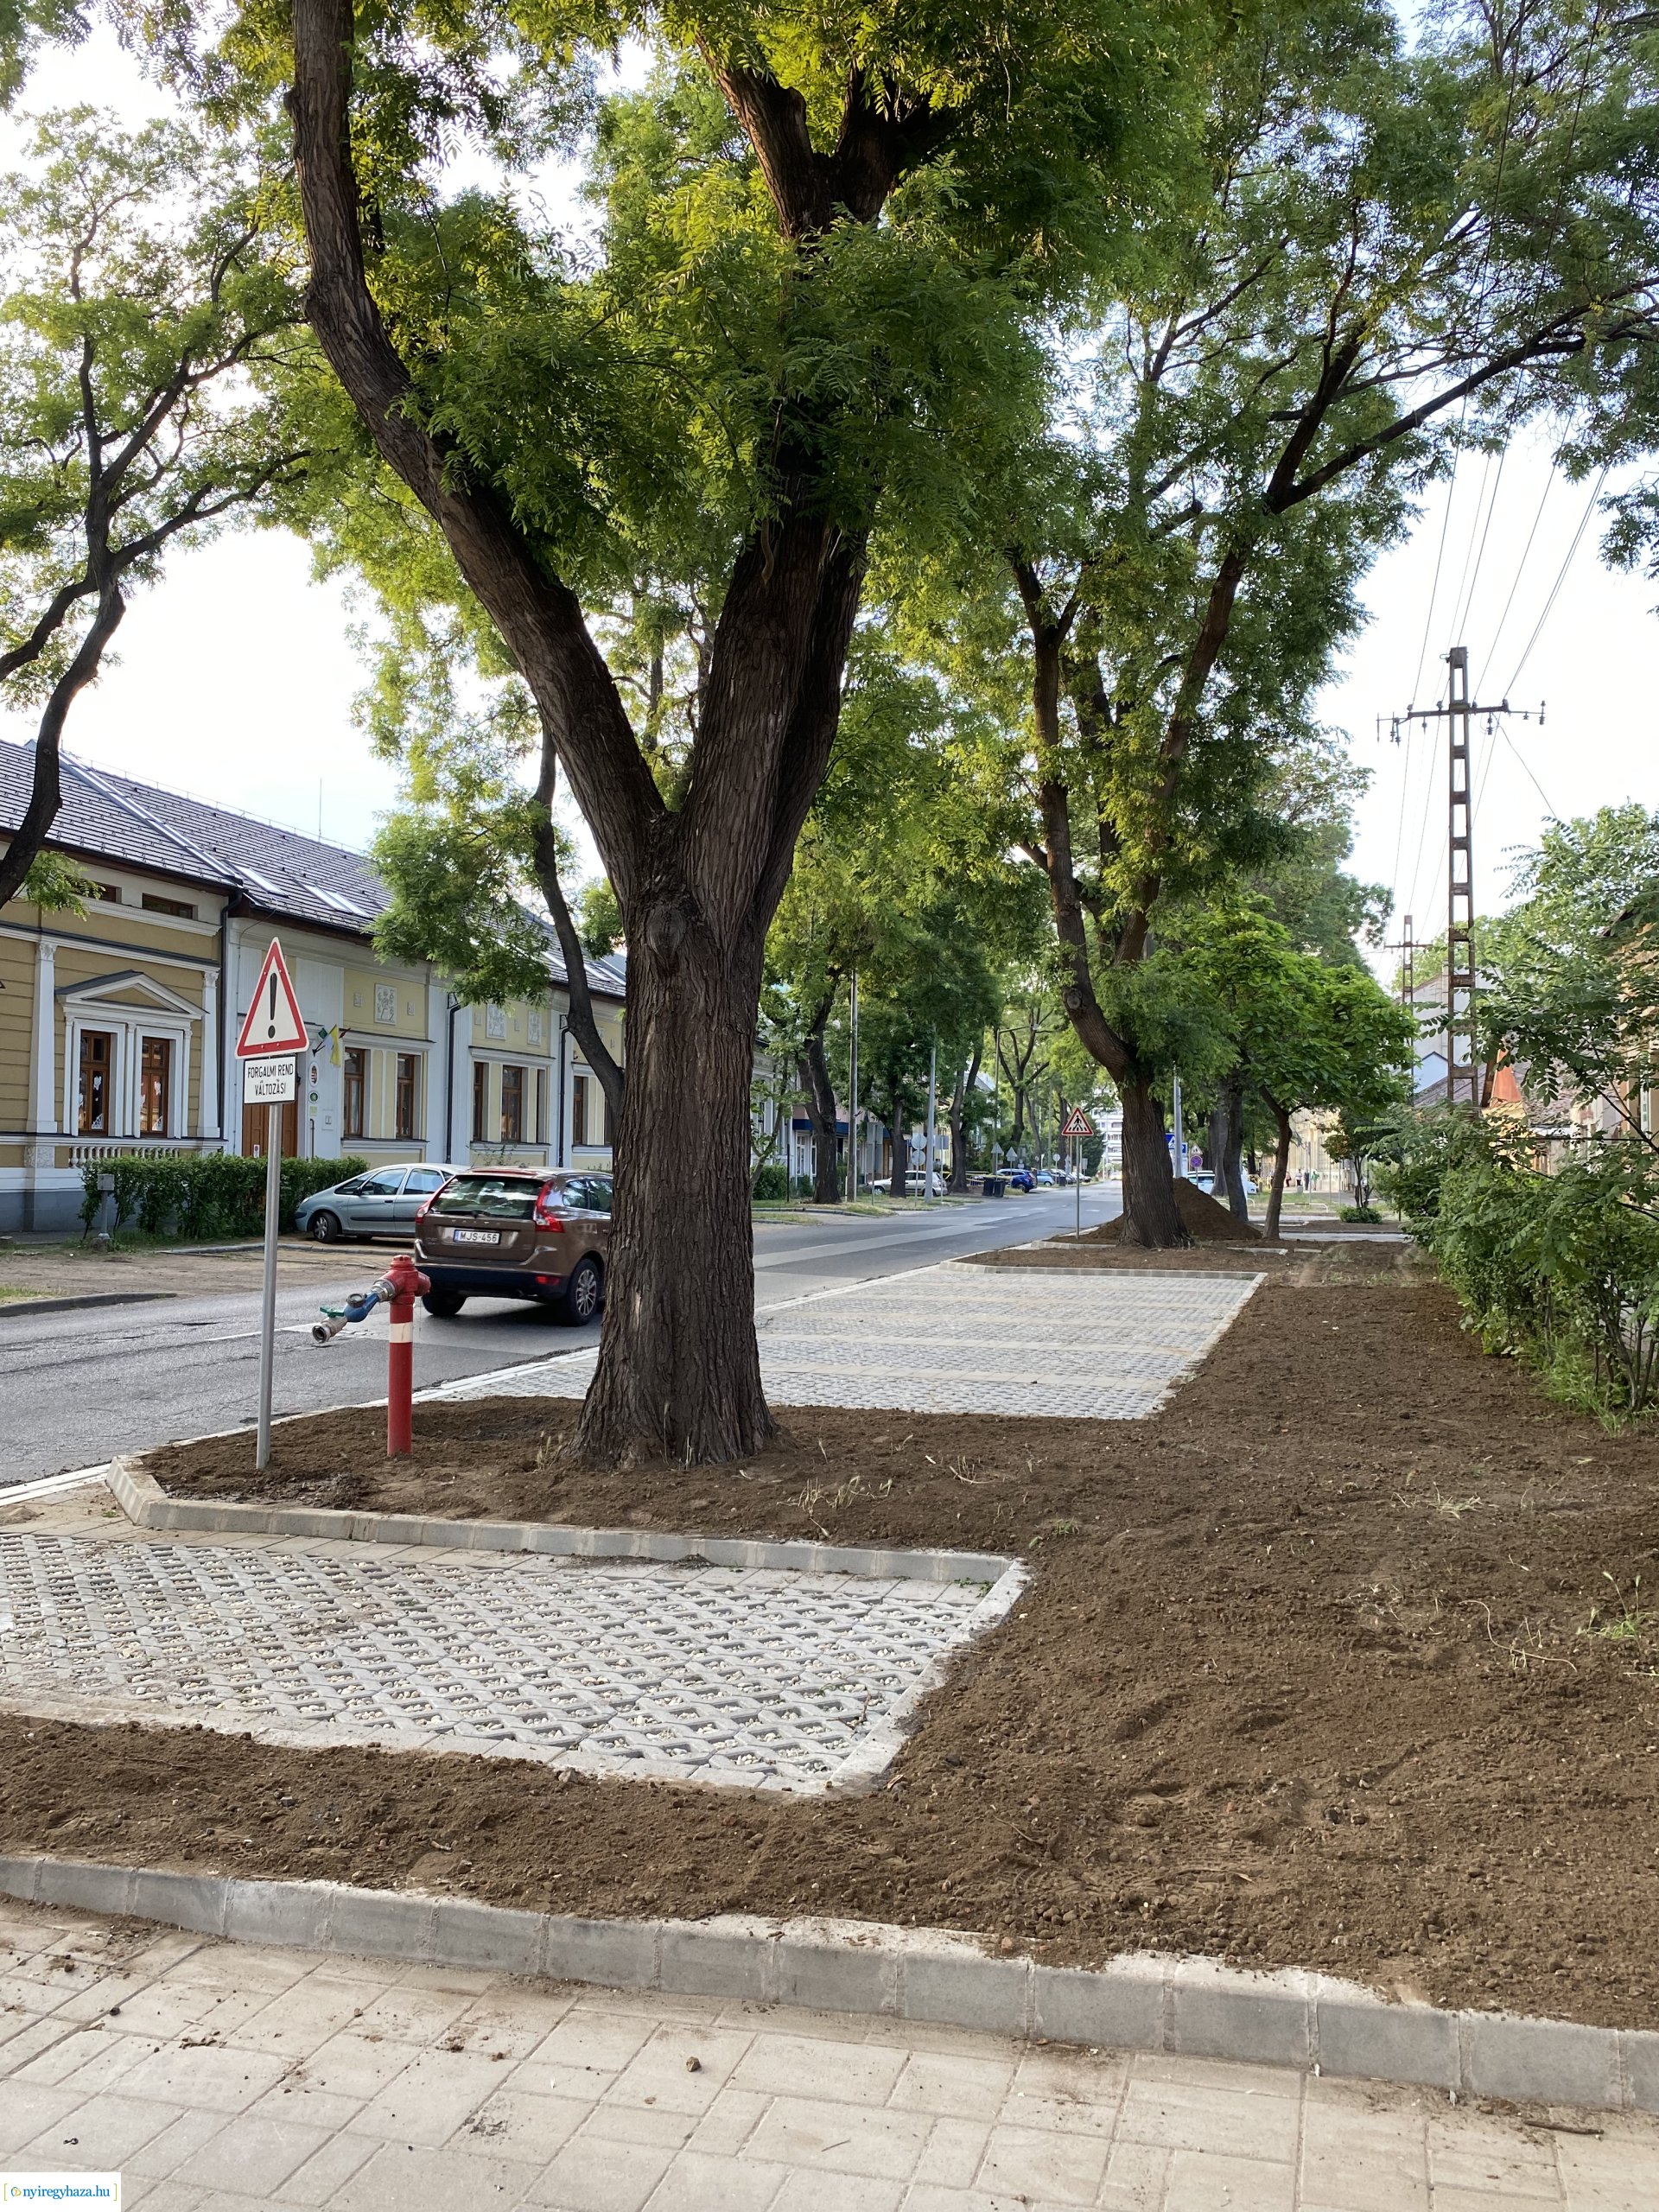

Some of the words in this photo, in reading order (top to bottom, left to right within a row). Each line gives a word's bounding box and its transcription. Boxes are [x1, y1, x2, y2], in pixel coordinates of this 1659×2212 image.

[247, 1065, 276, 1078] FORGALMI
[277, 1063, 295, 1077] REND
[460, 1231, 498, 1243] MJS-456
